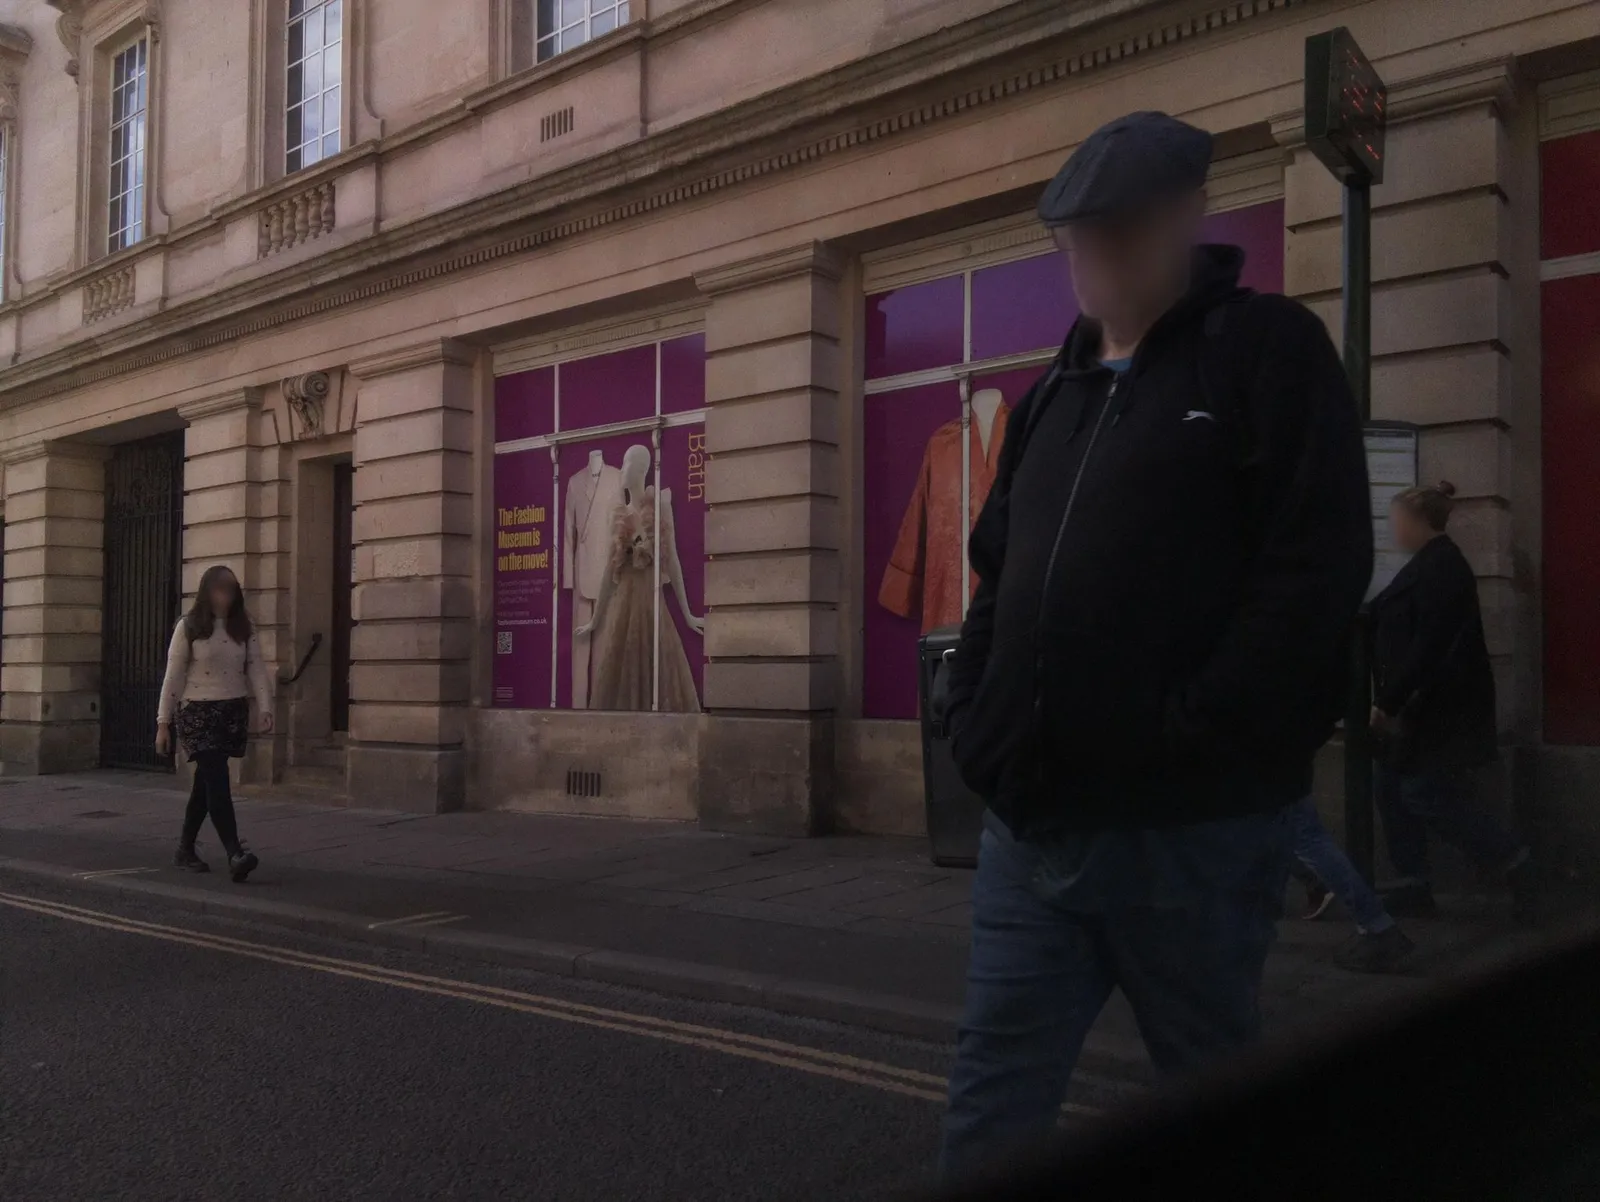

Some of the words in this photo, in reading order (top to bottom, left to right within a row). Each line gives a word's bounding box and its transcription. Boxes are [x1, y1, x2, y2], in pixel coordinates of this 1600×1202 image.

[688, 432, 705, 502] Bath
[498, 507, 513, 527] The
[513, 504, 545, 525] Fashion
[498, 530, 532, 549] Museum
[532, 527, 541, 546] is
[498, 556, 508, 571] on
[509, 552, 522, 571] the
[522, 548, 549, 569] move!
